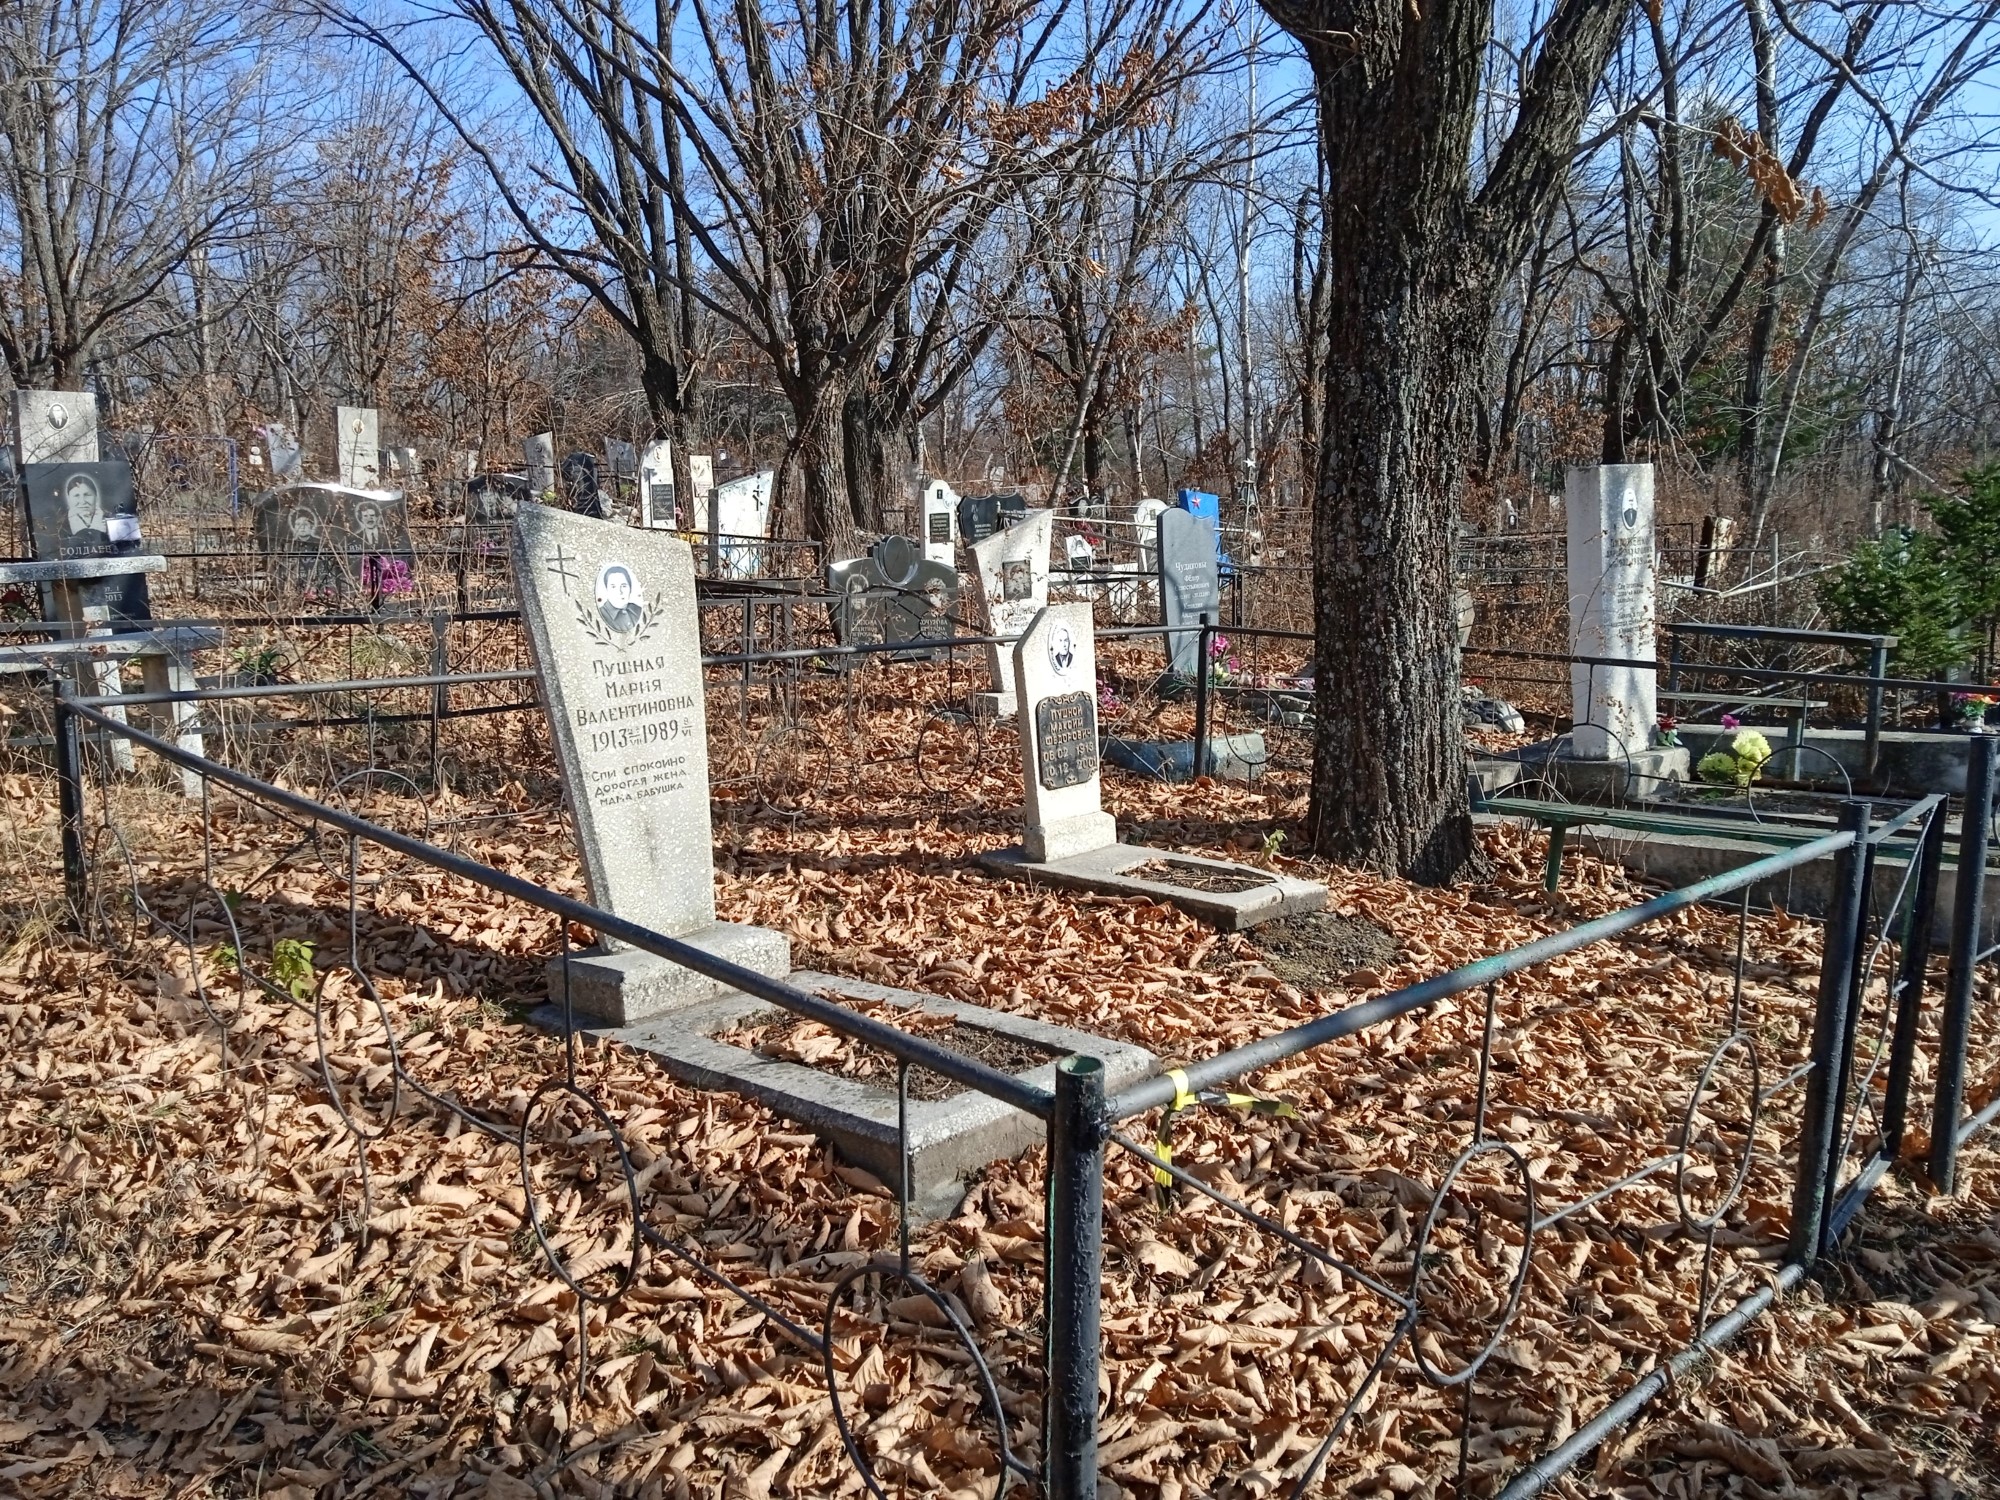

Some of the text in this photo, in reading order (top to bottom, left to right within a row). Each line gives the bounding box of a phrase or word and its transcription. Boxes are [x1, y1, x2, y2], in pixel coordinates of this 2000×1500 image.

[593, 656, 664, 677] ПУШНАЯ
[605, 679, 662, 698] МАРИЯ
[577, 695, 694, 726] ВАЛЕНТИНОВНА
[643, 719, 678, 743] 1989
[1050, 717, 1084, 734] МАКСИМ
[637, 782, 684, 799] БАБУШКА
